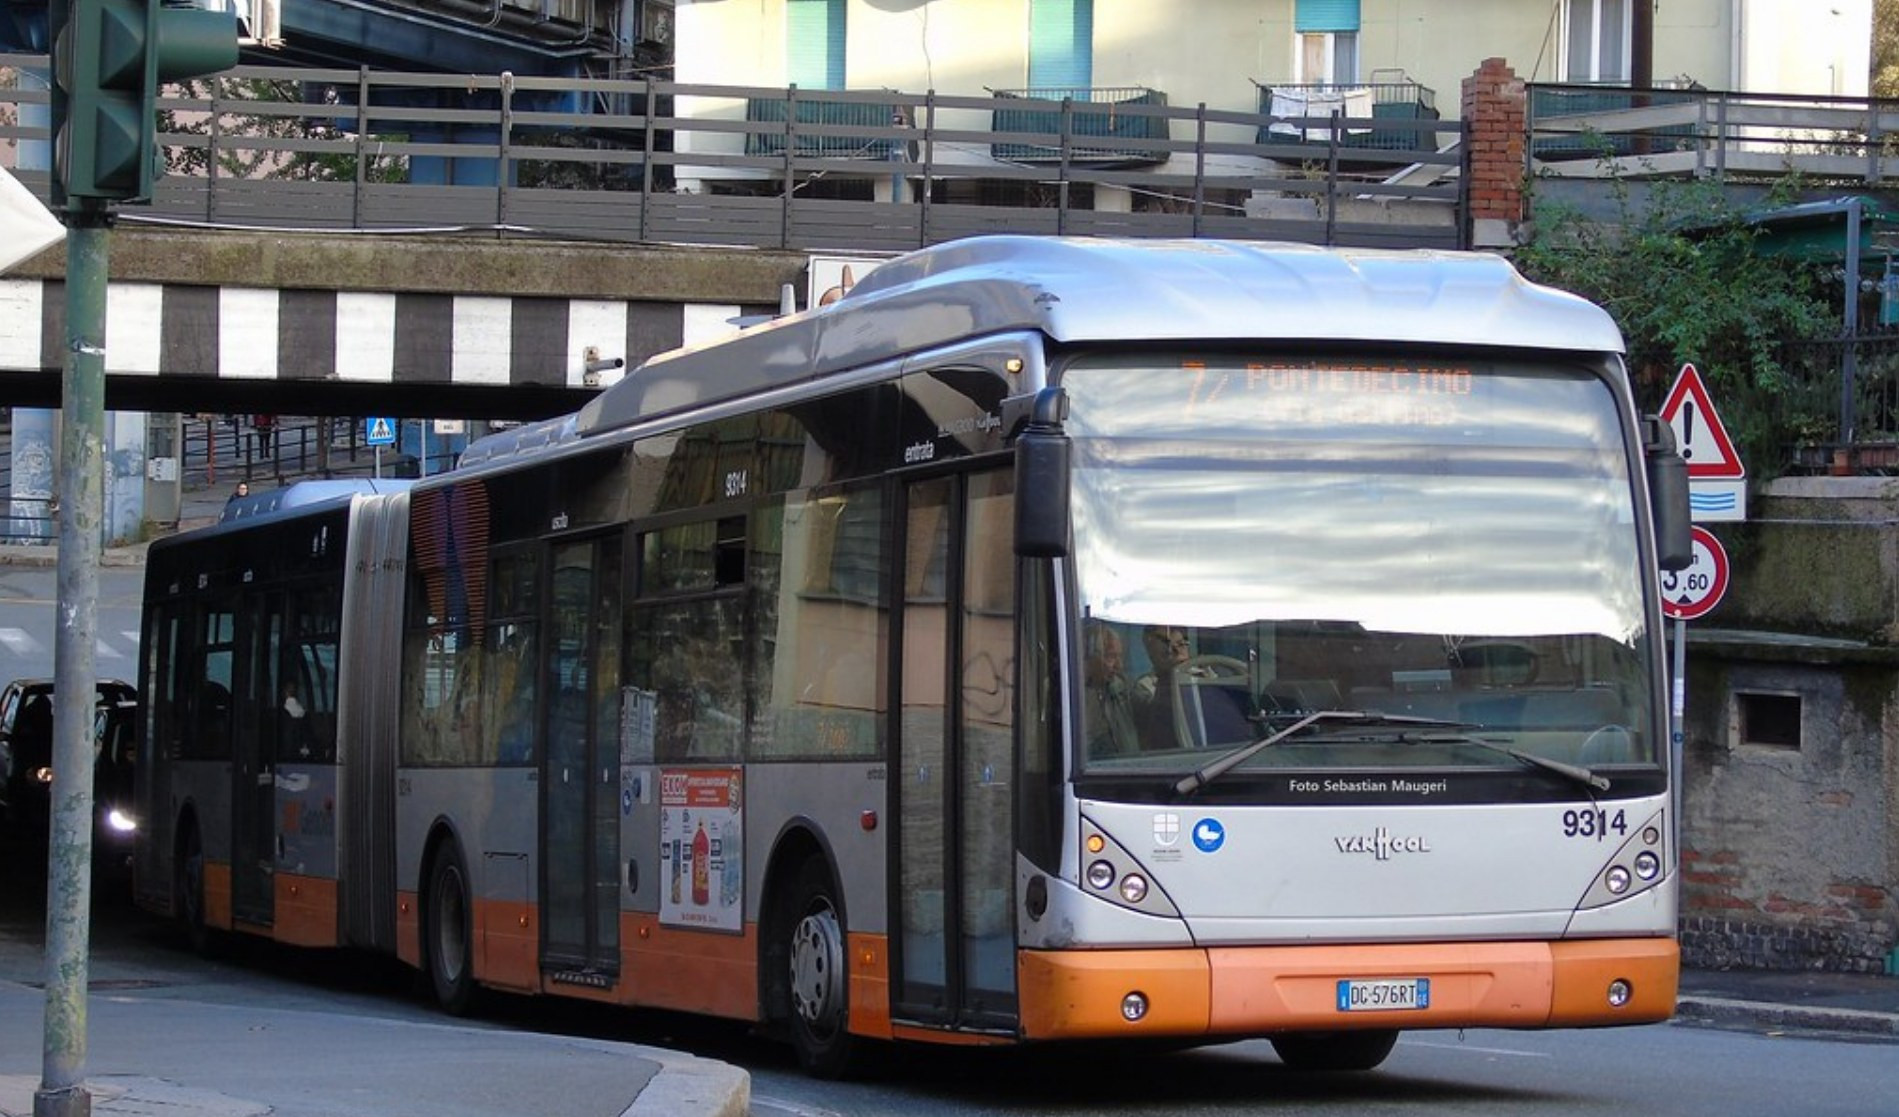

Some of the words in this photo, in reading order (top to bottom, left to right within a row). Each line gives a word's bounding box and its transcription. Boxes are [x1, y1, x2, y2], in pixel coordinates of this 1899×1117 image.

[1247, 363, 1472, 396] PONTEDECIMO
[725, 469, 748, 498] 9314
[1563, 808, 1628, 838] 9314
